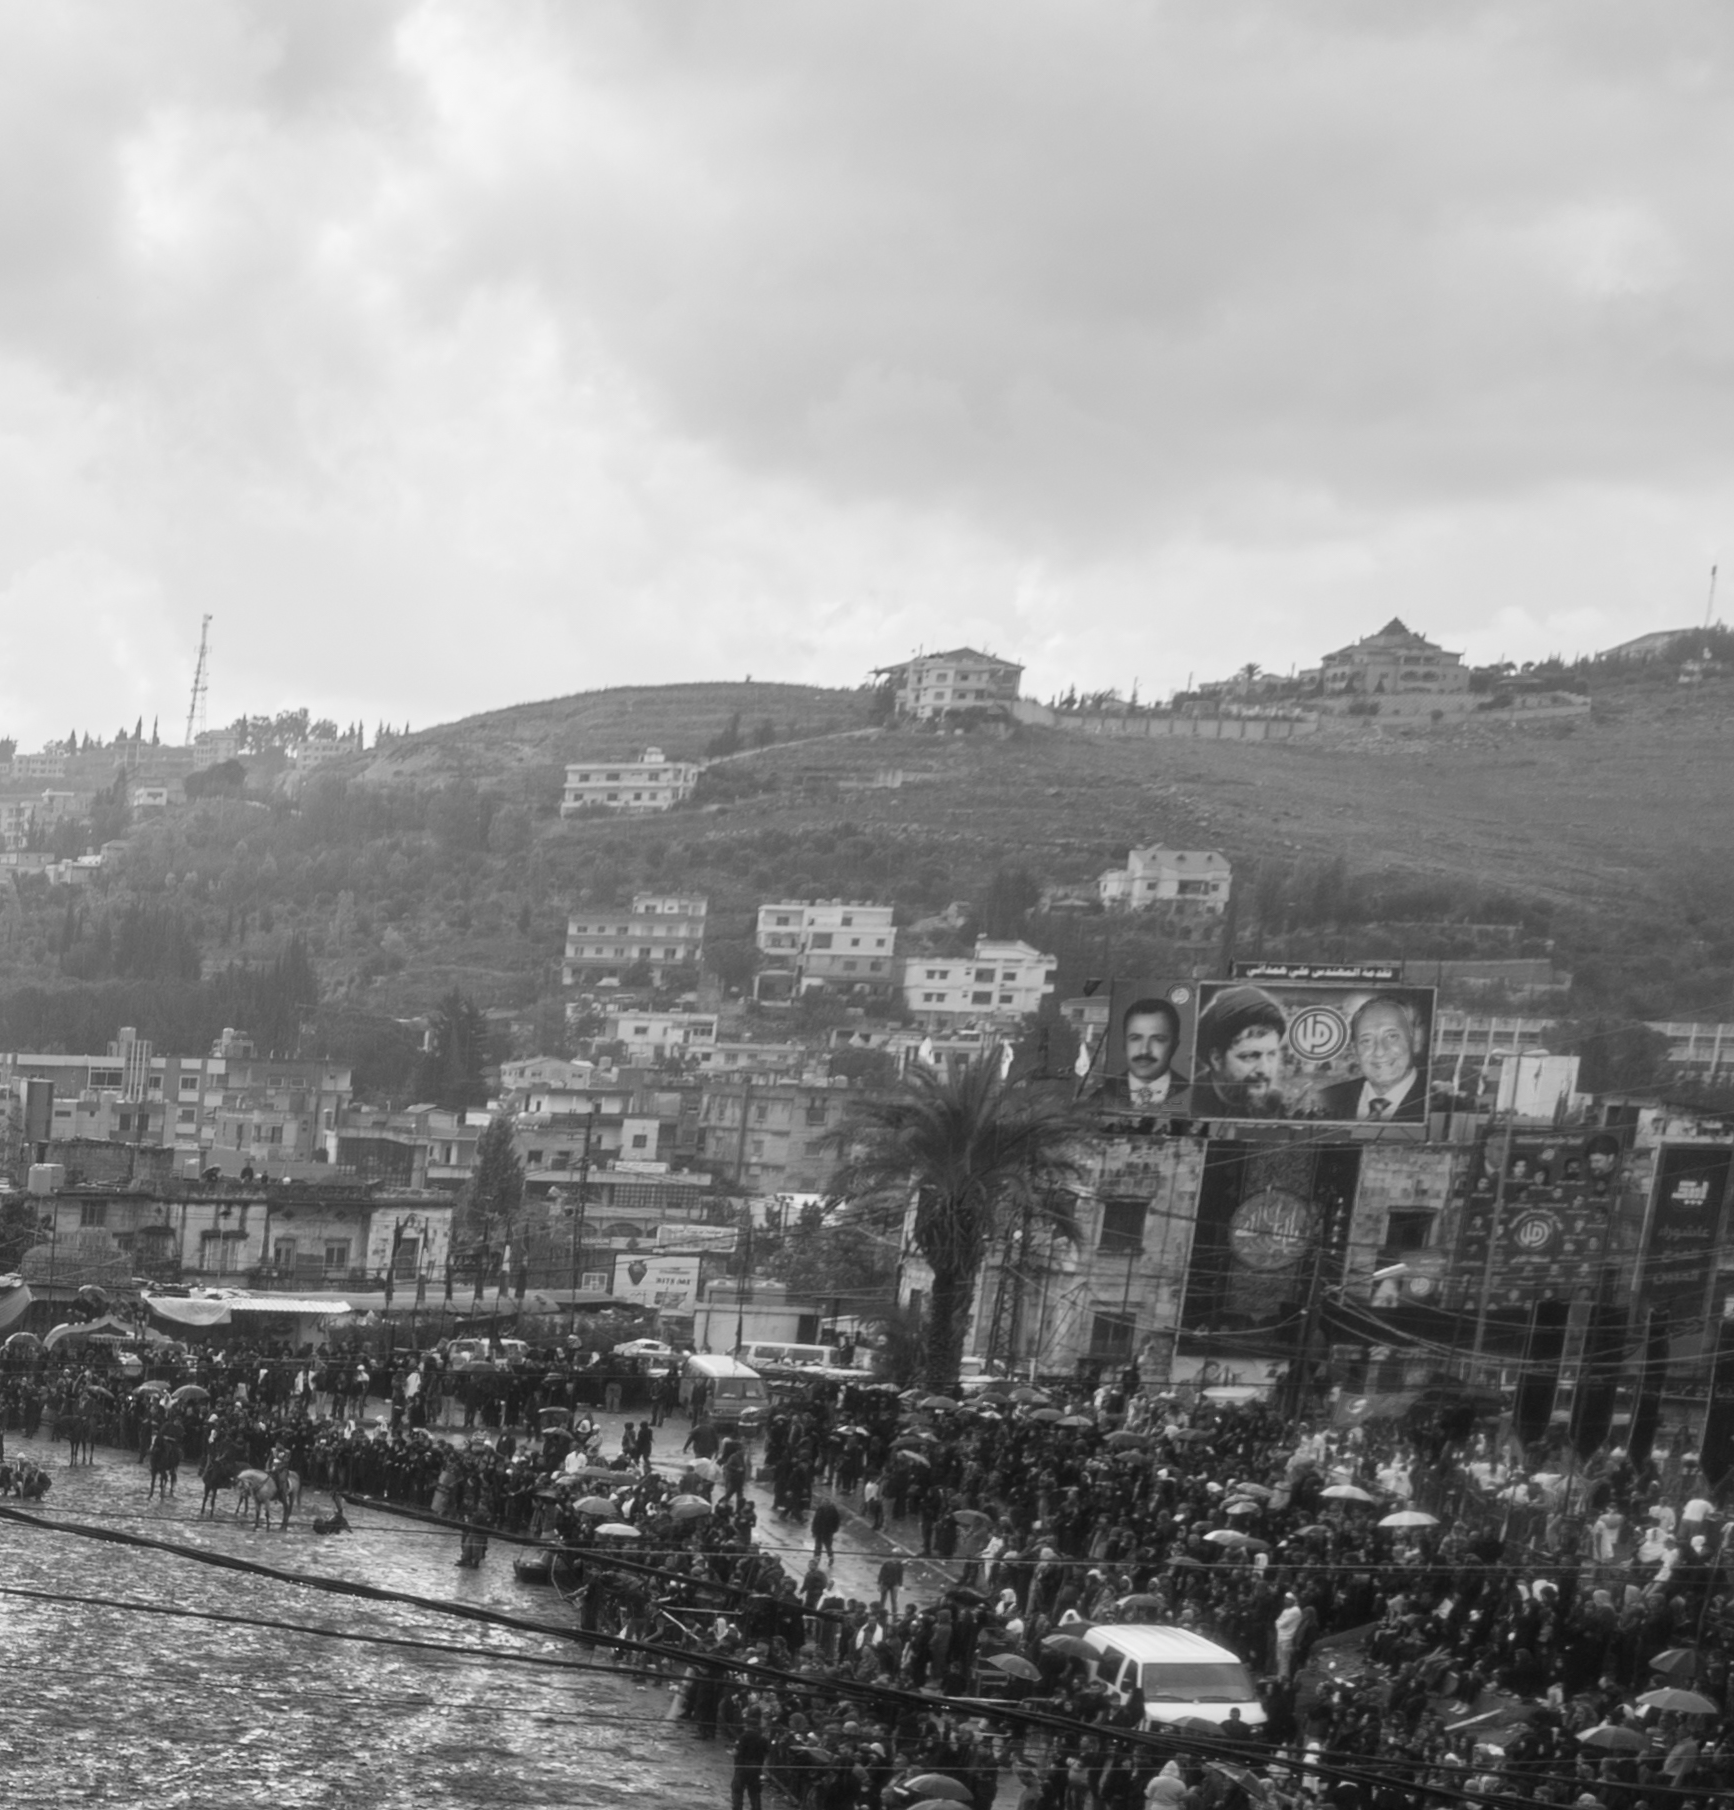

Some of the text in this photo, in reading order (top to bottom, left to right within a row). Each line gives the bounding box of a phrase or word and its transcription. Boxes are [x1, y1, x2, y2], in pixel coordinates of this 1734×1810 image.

[1245, 962, 1288, 978] همداني
[1288, 964, 1310, 979] علي
[1311, 966, 1361, 979] المهندس
